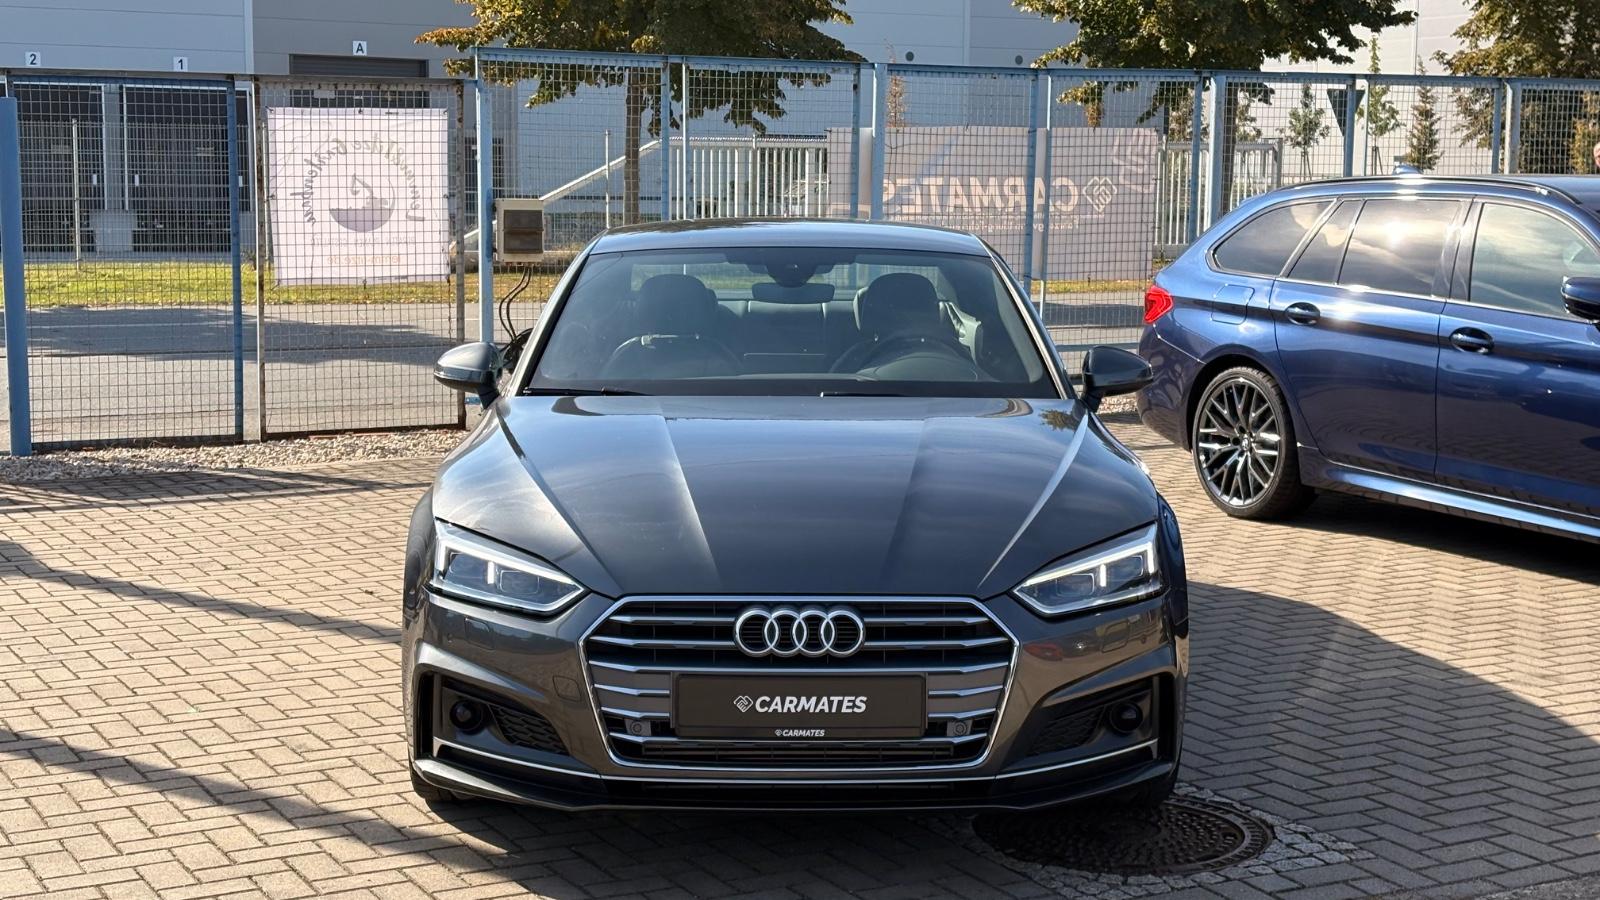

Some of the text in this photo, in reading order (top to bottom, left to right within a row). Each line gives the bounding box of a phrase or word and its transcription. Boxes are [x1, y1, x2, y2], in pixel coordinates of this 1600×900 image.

[356, 42, 365, 54] A
[29, 53, 37, 65] 2
[177, 58, 184, 70] 1
[755, 695, 867, 713] CARMATES
[782, 729, 825, 737] CARMATES
